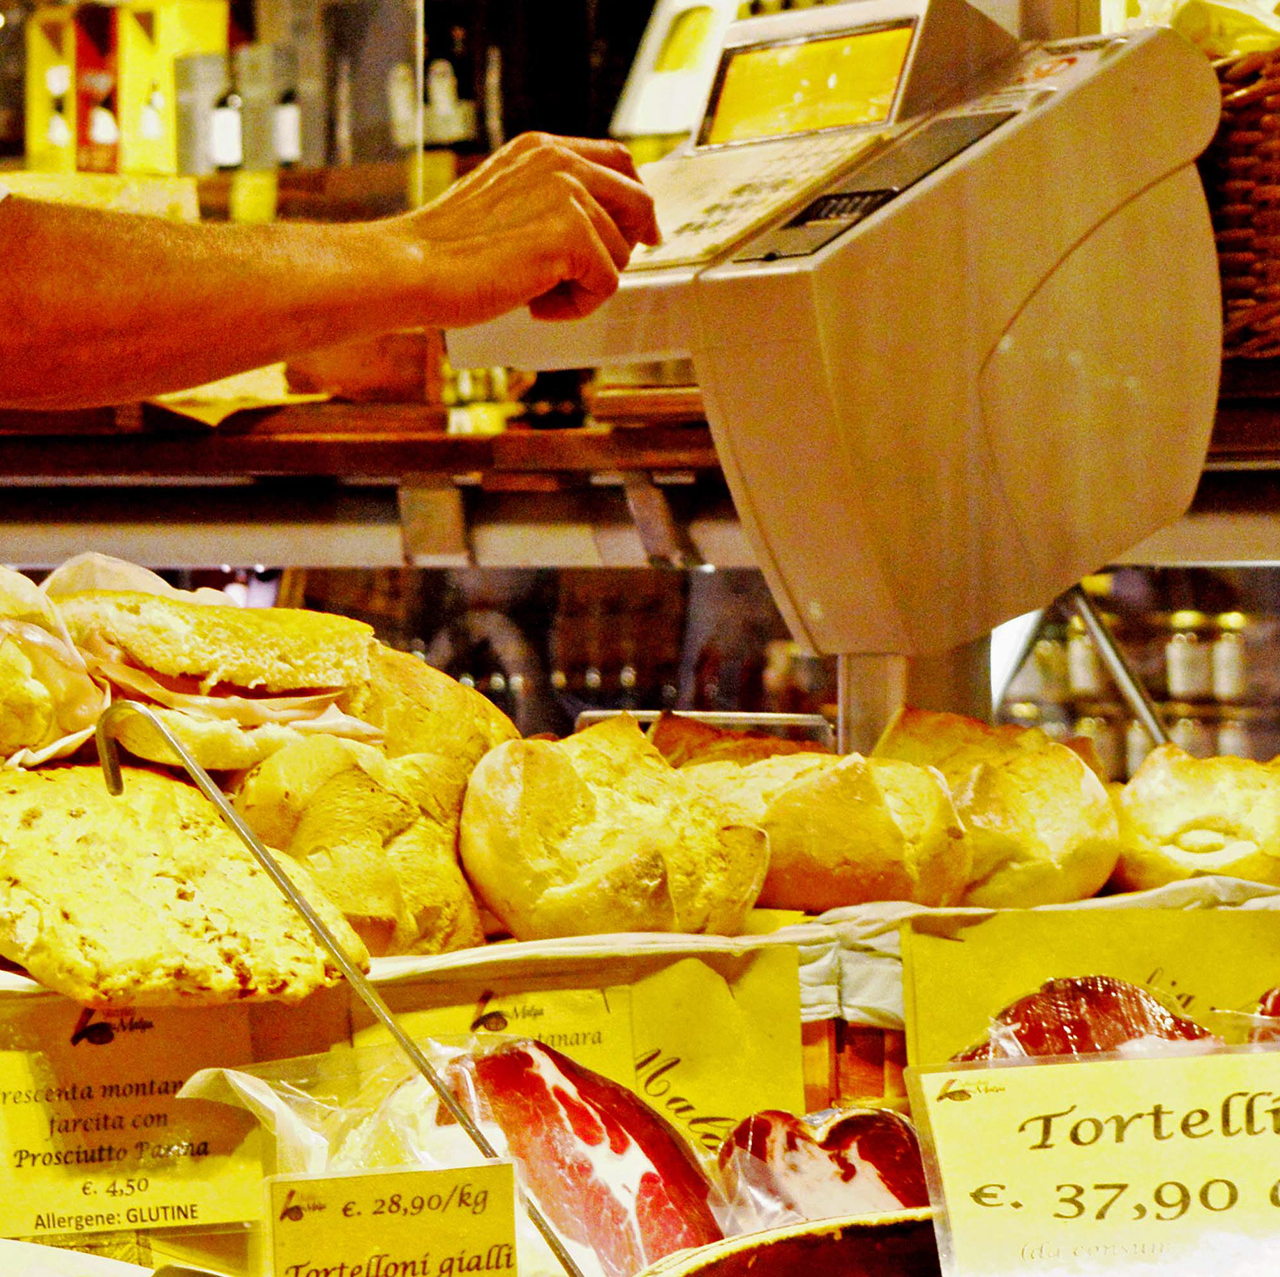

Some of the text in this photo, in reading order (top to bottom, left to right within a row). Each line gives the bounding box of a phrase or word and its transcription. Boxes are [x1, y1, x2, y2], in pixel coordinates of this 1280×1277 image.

[45, 1111, 168, 1141] farcita con
[13, 1144, 127, 1168] Prosciutto
[106, 1177, 149, 1197] 4,50
[372, 1183, 488, 1216] 28,90/kg
[969, 1183, 1024, 1210] €.
[1053, 1178, 1239, 1222] 37,90
[34, 1204, 199, 1231] Allergene: GLUTINE
[439, 1242, 514, 1277] gialli
